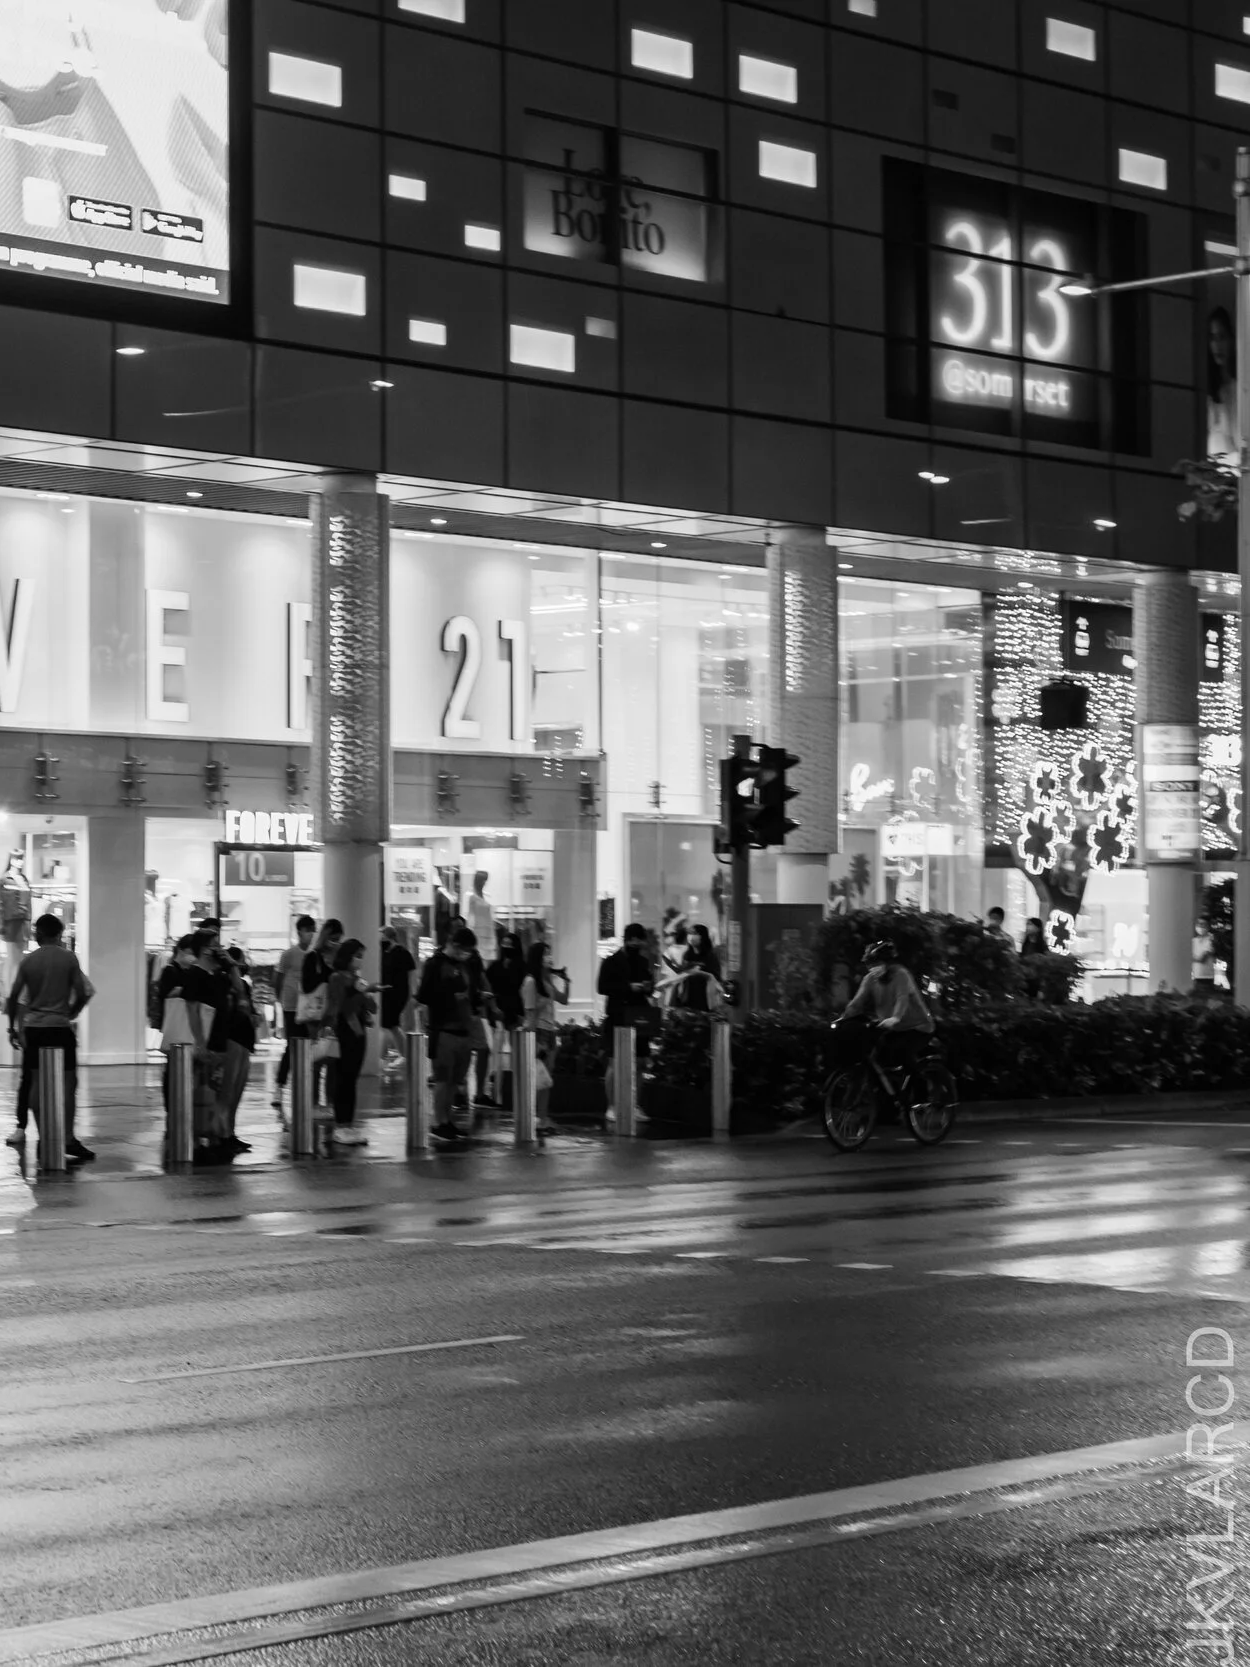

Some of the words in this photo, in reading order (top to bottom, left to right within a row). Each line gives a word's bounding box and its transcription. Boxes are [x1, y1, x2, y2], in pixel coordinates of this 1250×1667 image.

[562, 148, 652, 217] Loe,
[551, 190, 665, 255] Boito
[941, 221, 1071, 356] 313
[943, 359, 1071, 406] @somrset
[442, 615, 526, 740] 21
[1151, 781, 1194, 792] SONY
[225, 810, 315, 845] FOREVE
